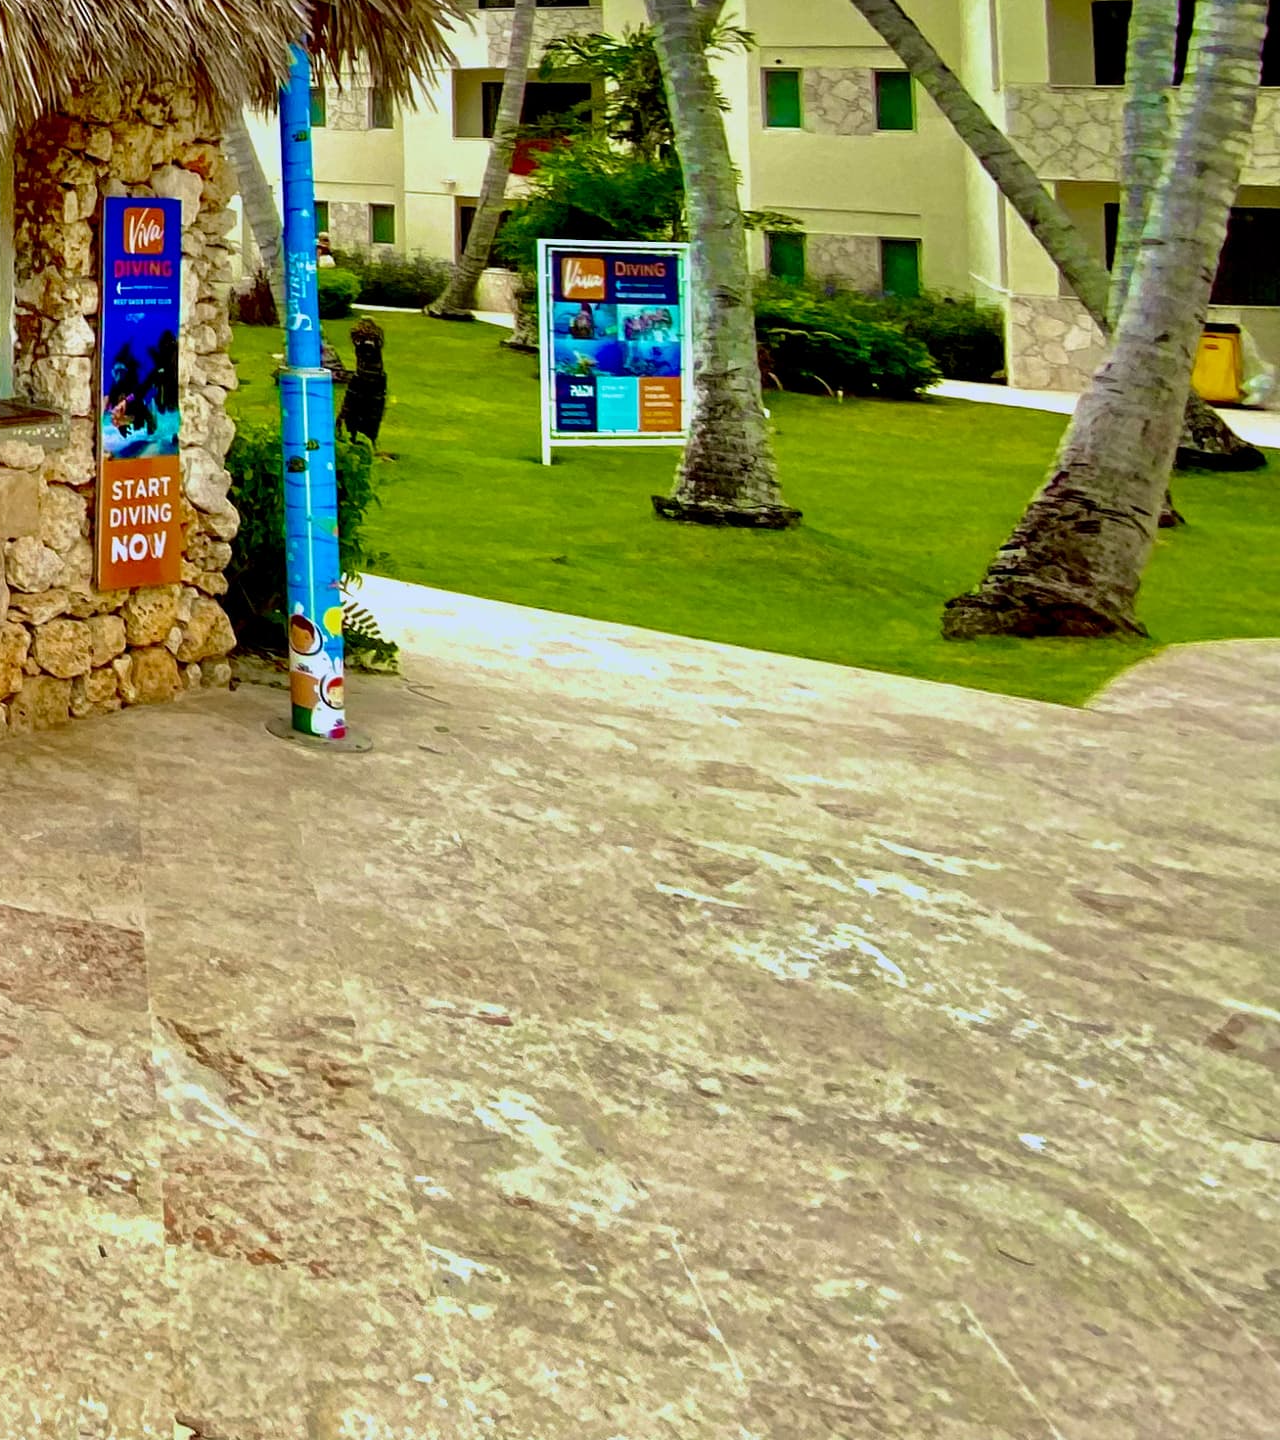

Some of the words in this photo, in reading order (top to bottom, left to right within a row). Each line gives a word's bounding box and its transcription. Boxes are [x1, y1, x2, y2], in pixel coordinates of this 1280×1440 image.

[128, 207, 165, 255] Viva
[114, 260, 173, 278] DIVING
[562, 259, 605, 297] Viva
[614, 261, 667, 277] DIVING
[112, 476, 172, 501] START
[109, 503, 172, 528] DIVING
[111, 530, 167, 564] NOW
